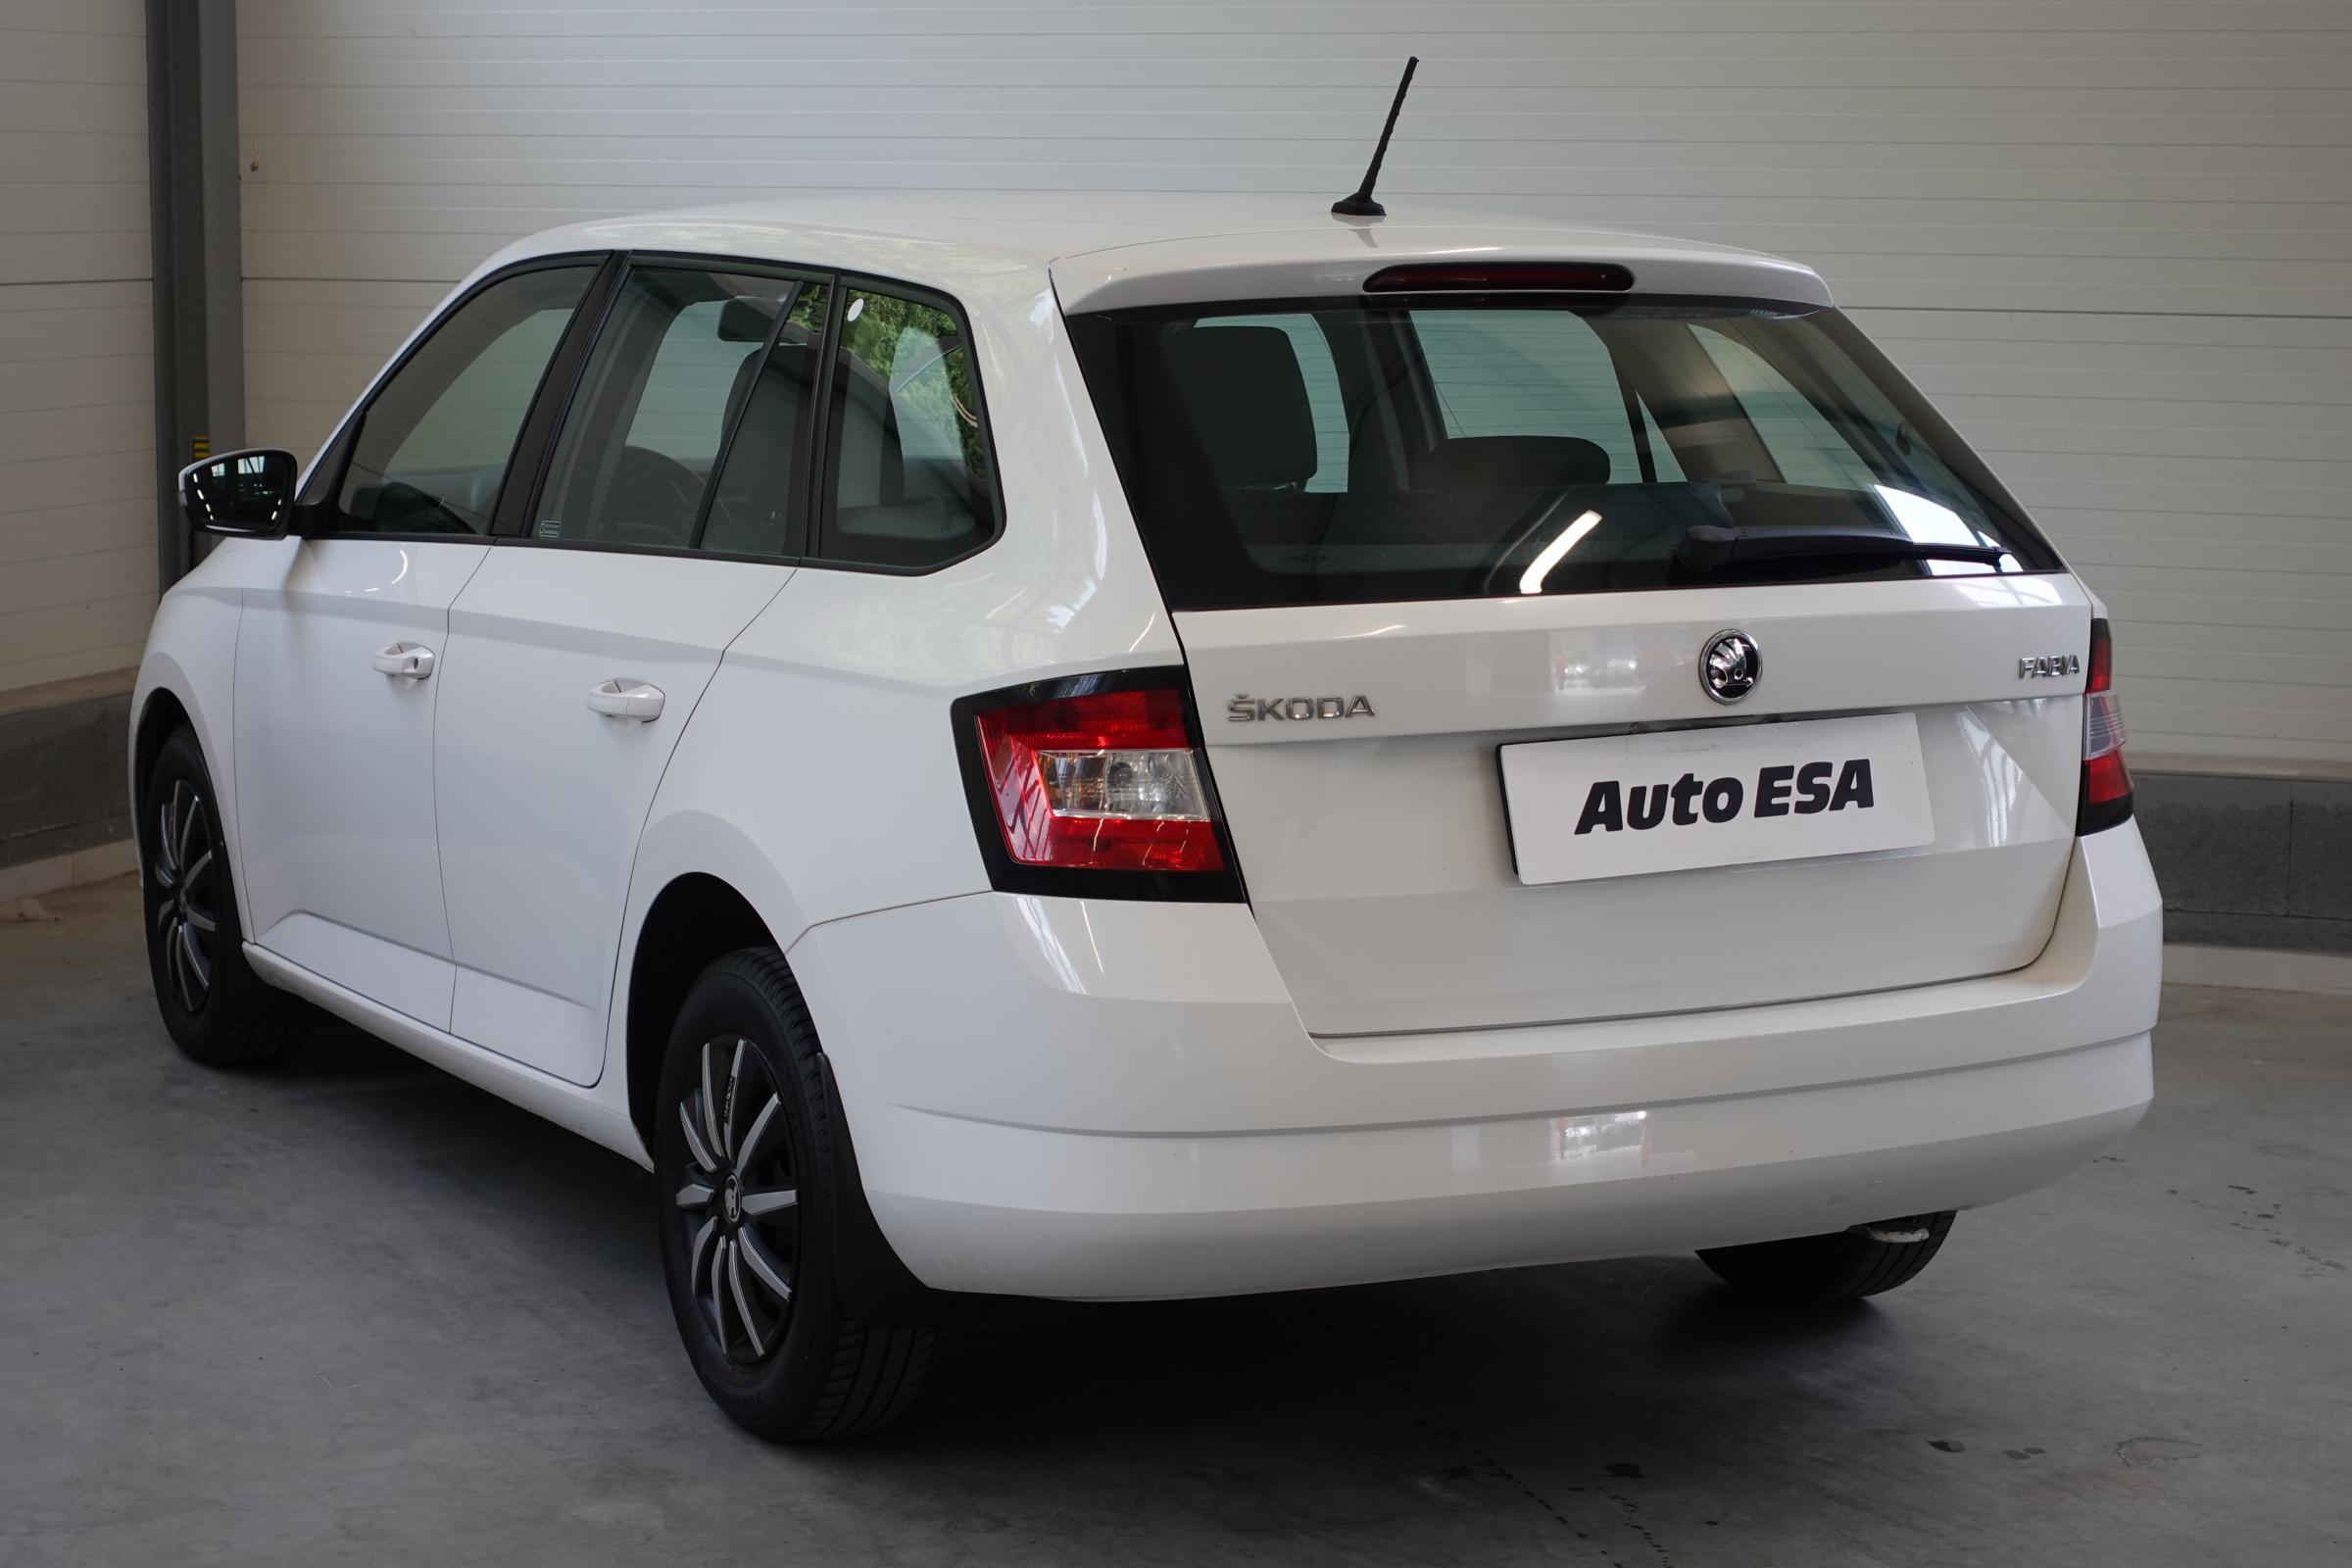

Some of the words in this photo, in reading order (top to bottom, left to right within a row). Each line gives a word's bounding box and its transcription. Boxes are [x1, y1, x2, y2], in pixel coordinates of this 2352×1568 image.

[2019, 655, 2080, 679] FABIA
[1227, 693, 1375, 722] ŠKODA
[1574, 772, 1743, 835] Auto
[1754, 759, 1875, 817] ESA
